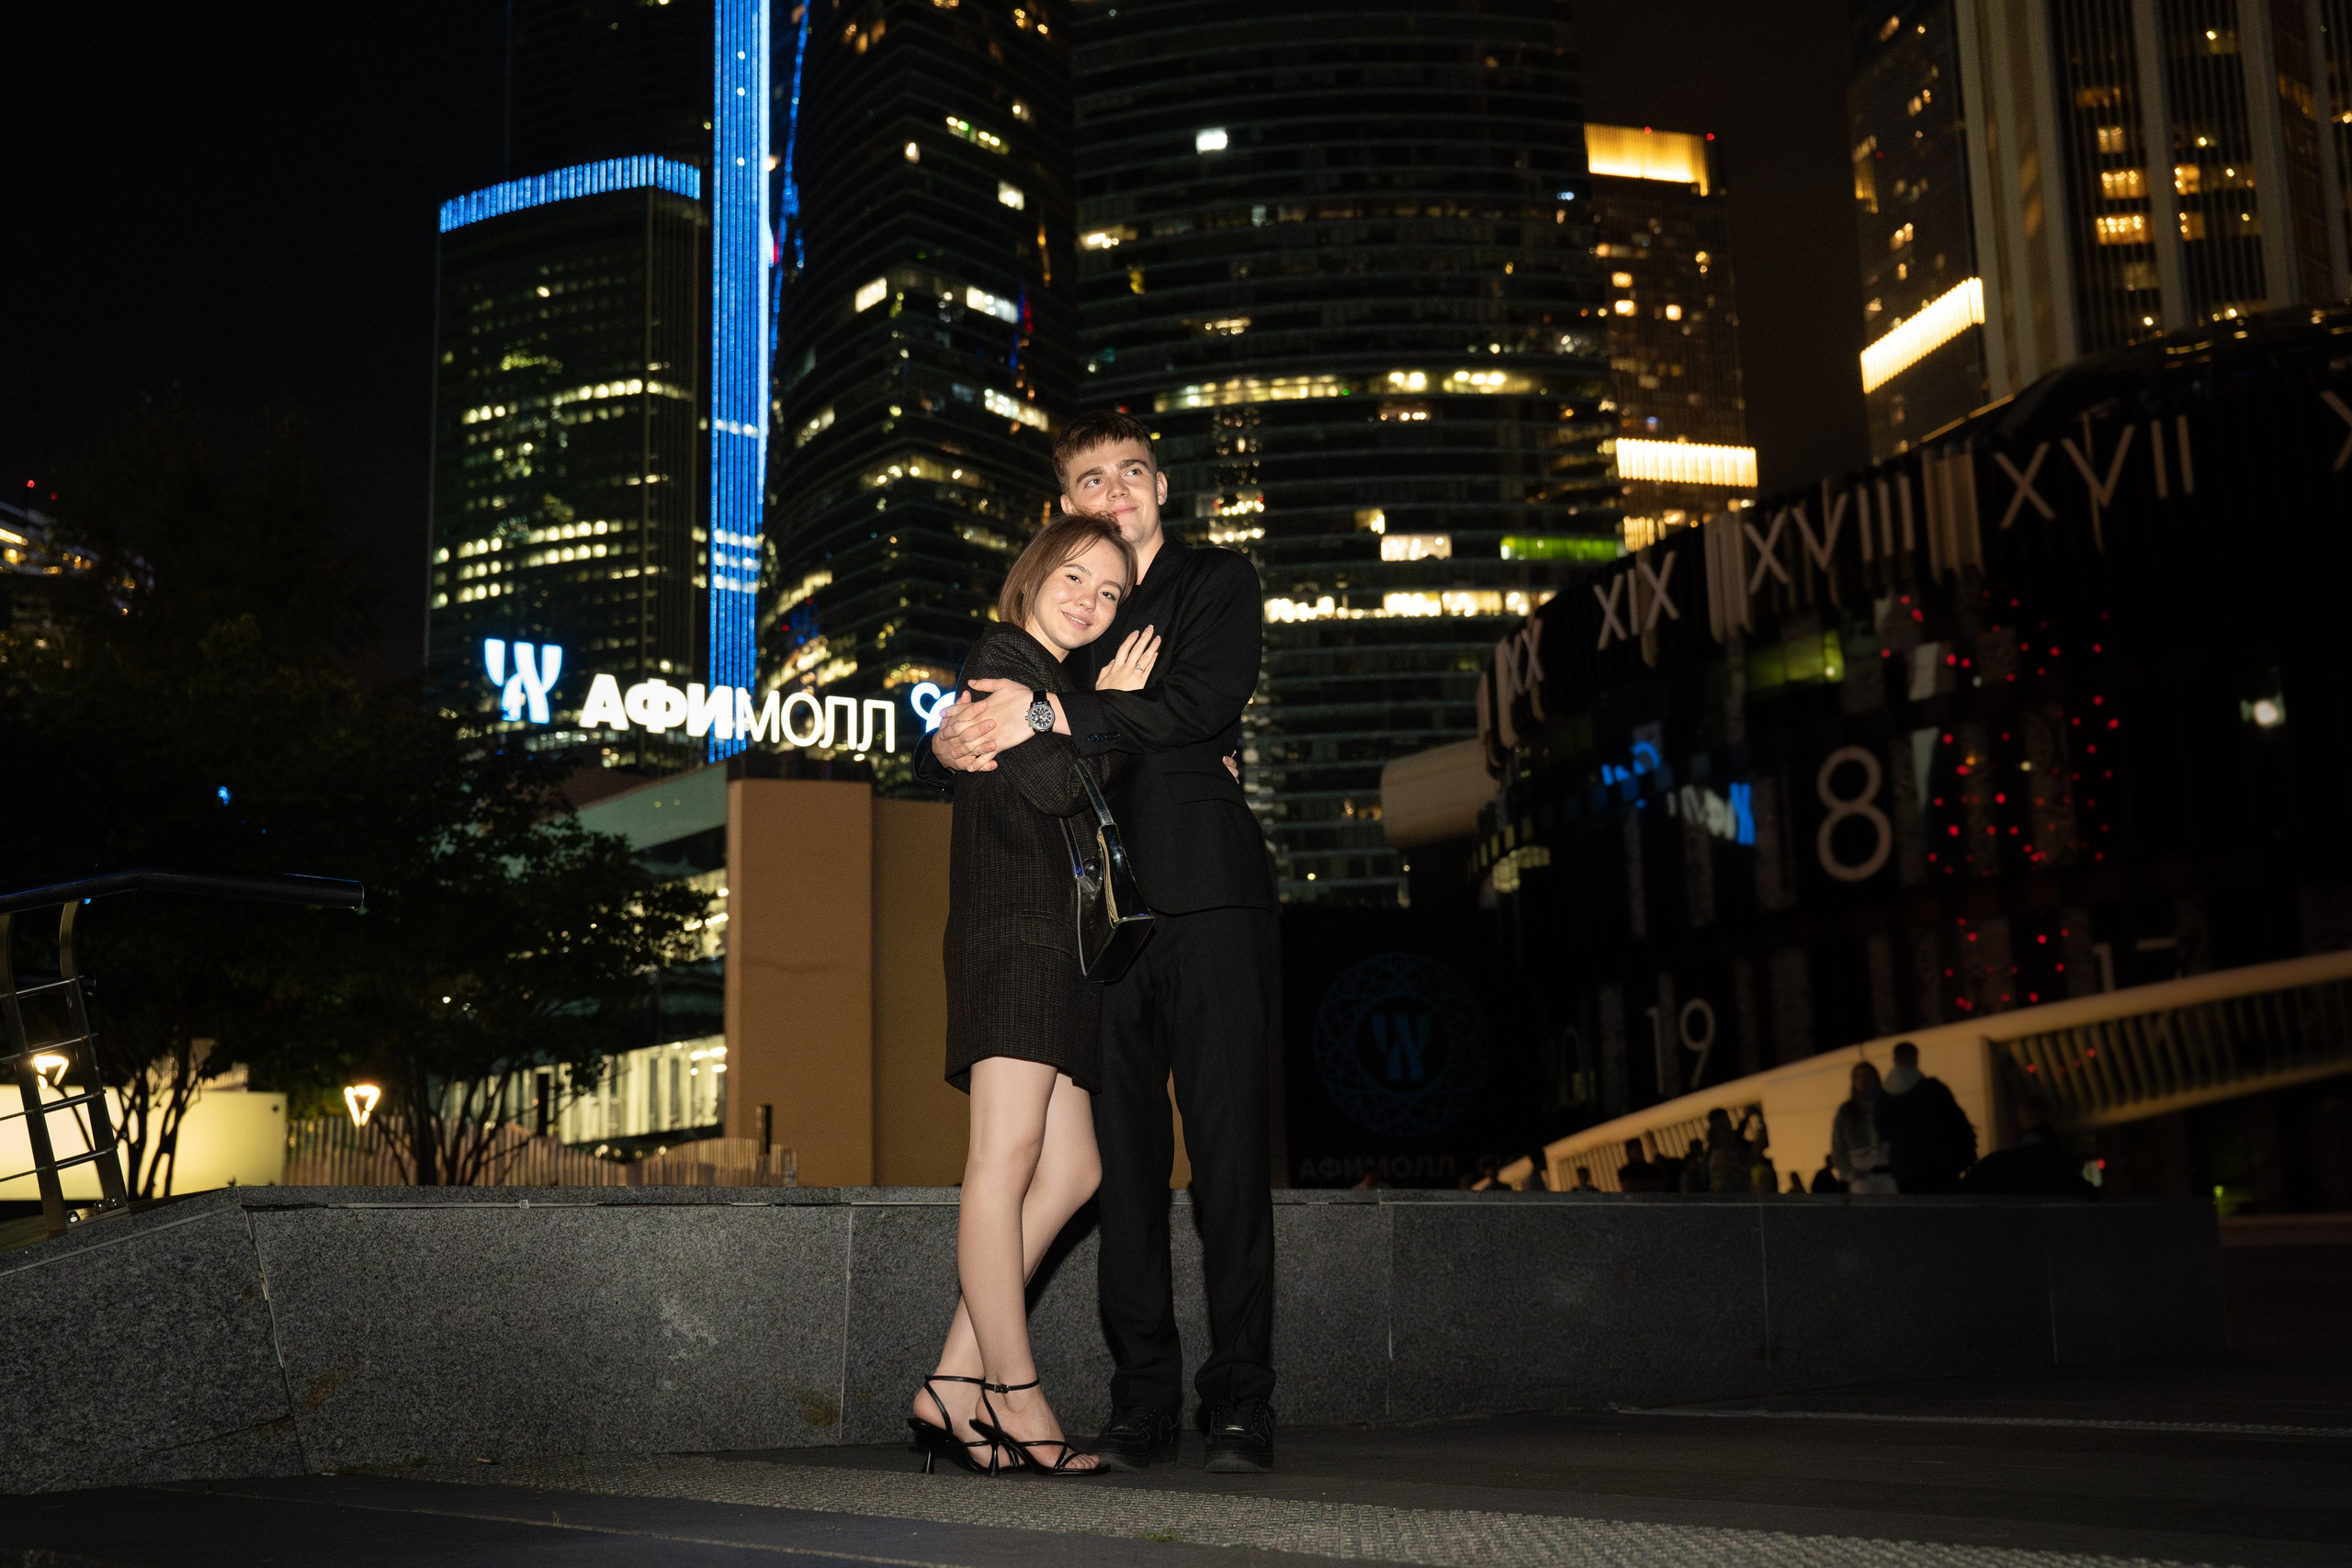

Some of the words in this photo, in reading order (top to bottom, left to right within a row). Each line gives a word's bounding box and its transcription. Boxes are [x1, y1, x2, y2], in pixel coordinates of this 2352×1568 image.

[1993, 412, 2196, 533] XVII
[1743, 471, 1917, 595] XVIII
[1591, 548, 1680, 652] XIX
[578, 672, 897, 754] АФИМОЛЛ
[1644, 996, 1716, 1096] 19
